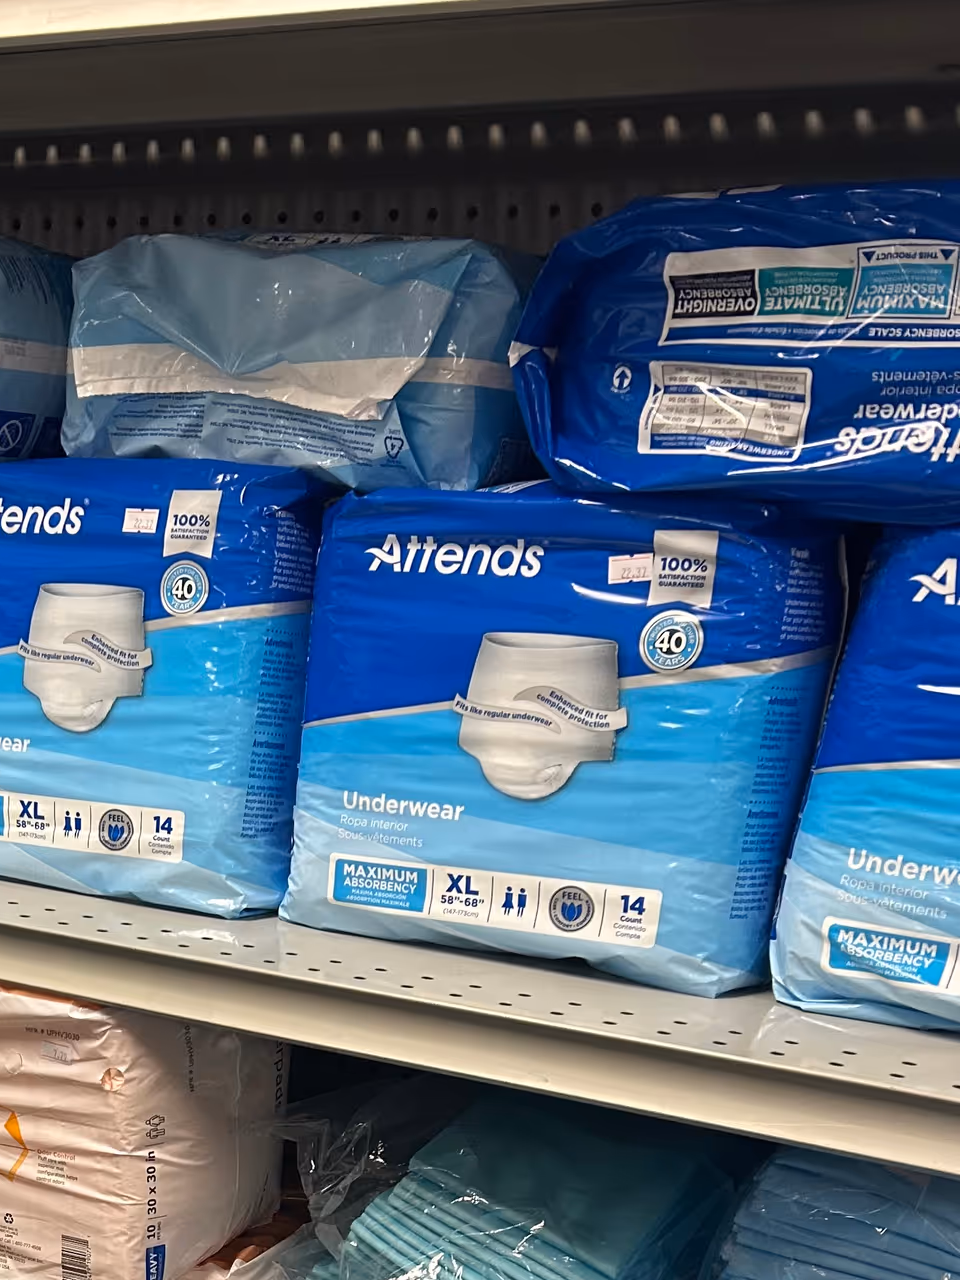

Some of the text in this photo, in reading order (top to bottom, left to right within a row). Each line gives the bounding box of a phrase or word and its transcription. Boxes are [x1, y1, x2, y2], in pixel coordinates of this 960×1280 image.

[679, 288, 752, 298] ABSORBENCY
[765, 284, 847, 298] ABSORBENCY
[861, 282, 944, 295] ABSORBENCY
[675, 298, 755, 313] OVERNIGHT
[764, 296, 844, 311] ULTIMATE
[857, 295, 944, 309] MAXIMUM
[173, 514, 210, 528] 100%
[365, 533, 544, 578] Attends
[660, 557, 707, 573] 100%
[659, 573, 705, 582] SATISFACTION
[172, 581, 195, 599] 40
[92, 634, 118, 657] Enhanced
[654, 631, 686, 653] 40
[41, 652, 95, 666] regular underwear
[81, 637, 139, 667] complete protection
[653, 653, 685, 665] YEARS
[455, 701, 552, 728] Fits like regular underwear
[536, 693, 610, 729] complete protection
[550, 690, 608, 721] Enhanced fit for
[19, 800, 45, 820] XL
[343, 791, 464, 821] Underwear
[109, 815, 125, 823] FEEL
[153, 816, 173, 834] 14
[341, 814, 408, 831] Ropa interior
[153, 835, 170, 843] Count
[343, 864, 418, 883] MAXIMUM
[344, 877, 417, 895] ABSORBENCY
[447, 874, 479, 896] XL
[562, 892, 583, 901] FEEL
[620, 895, 645, 916] 14
[613, 923, 646, 933] Contenido
[620, 916, 642, 925] Count
[836, 929, 937, 958] MAXIMUM
[840, 945, 934, 968] ABSORBENCY
[146, 1151, 156, 1239] 10 30 30 in
